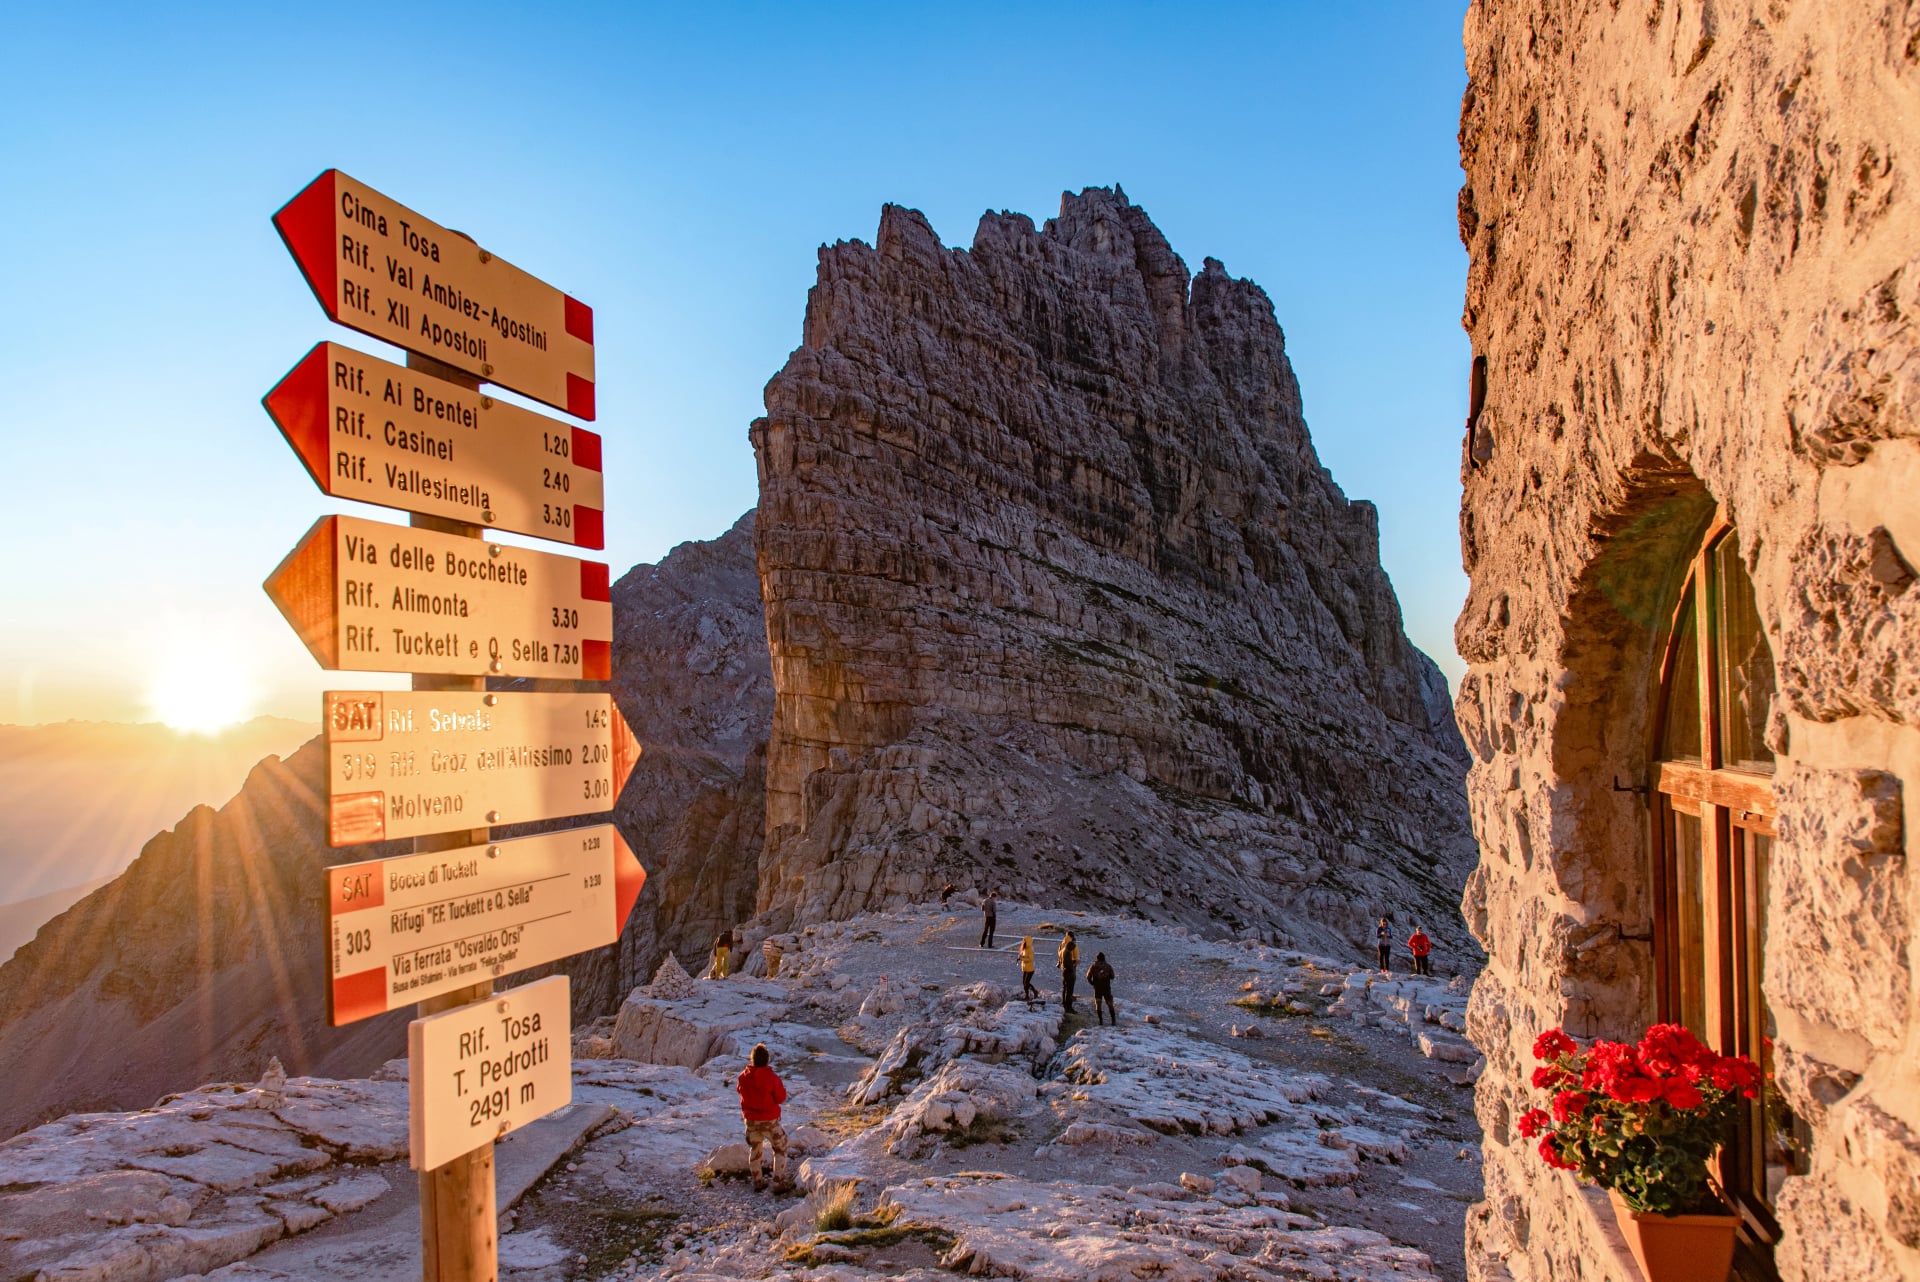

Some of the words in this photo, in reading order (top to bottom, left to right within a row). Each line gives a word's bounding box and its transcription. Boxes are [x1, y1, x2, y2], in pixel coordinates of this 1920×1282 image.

[342, 191, 388, 236] Cima
[399, 220, 440, 263] Tosa
[342, 234, 375, 273] Rif.
[386, 255, 413, 290] Val
[422, 274, 547, 352] Ambiez-Agostini
[343, 278, 376, 316] Rif.
[387, 297, 410, 330] XII
[420, 314, 487, 362] Apostoli
[335, 361, 370, 397] Rif.
[383, 378, 402, 406] Ai
[414, 387, 478, 429] Brentei
[543, 432, 569, 458] 1.20
[336, 406, 371, 440] Rif.
[384, 420, 453, 462] Casinei
[543, 468, 570, 493] 2.40
[337, 451, 373, 484] Rif.
[385, 462, 490, 509] Vallesinella
[543, 504, 571, 529] 3.30
[345, 534, 377, 565] Via
[390, 543, 435, 572] delle
[446, 551, 527, 586] Bocchette
[346, 579, 379, 609] Rif.
[392, 586, 468, 618] Alimonta
[552, 607, 578, 629] 3.30
[346, 625, 380, 653] Rif.
[393, 628, 458, 658] Tuckett
[469, 640, 478, 658] e
[489, 637, 503, 660] Q.
[512, 638, 548, 663] Sella
[553, 644, 579, 665] 7.30
[334, 701, 375, 731] SAT
[389, 709, 419, 733] Rif.
[430, 708, 491, 733] Selvata
[585, 709, 607, 729] 1.40
[343, 754, 376, 781] 319
[390, 751, 420, 777] Rif.
[431, 750, 467, 774] Croz
[477, 744, 572, 771] dell'Altissimo
[582, 745, 608, 765] 2.00
[391, 794, 463, 820] Molveno
[583, 779, 609, 799] 3.00
[342, 873, 372, 902] SAT
[390, 872, 425, 892] Bocca
[428, 865, 438, 884] di
[441, 860, 478, 882] Tuckett
[588, 837, 600, 850] 2:30
[391, 909, 425, 934] Rifugi
[448, 896, 485, 921] Tuckett
[495, 891, 506, 910] Q.
[507, 885, 533, 907] Sella"
[589, 874, 602, 887] 3:30
[346, 928, 371, 956] 303
[393, 956, 411, 977] Via
[414, 946, 452, 971] ferrata
[454, 933, 499, 959] "Osvaldo
[501, 925, 525, 947] Orsi"
[459, 1026, 490, 1061] Rif.
[501, 1013, 541, 1042] Tosa
[453, 1069, 468, 1097] T.
[480, 1037, 549, 1088] Pedrotti
[470, 1086, 510, 1127] 2491
[521, 1081, 535, 1105] m
